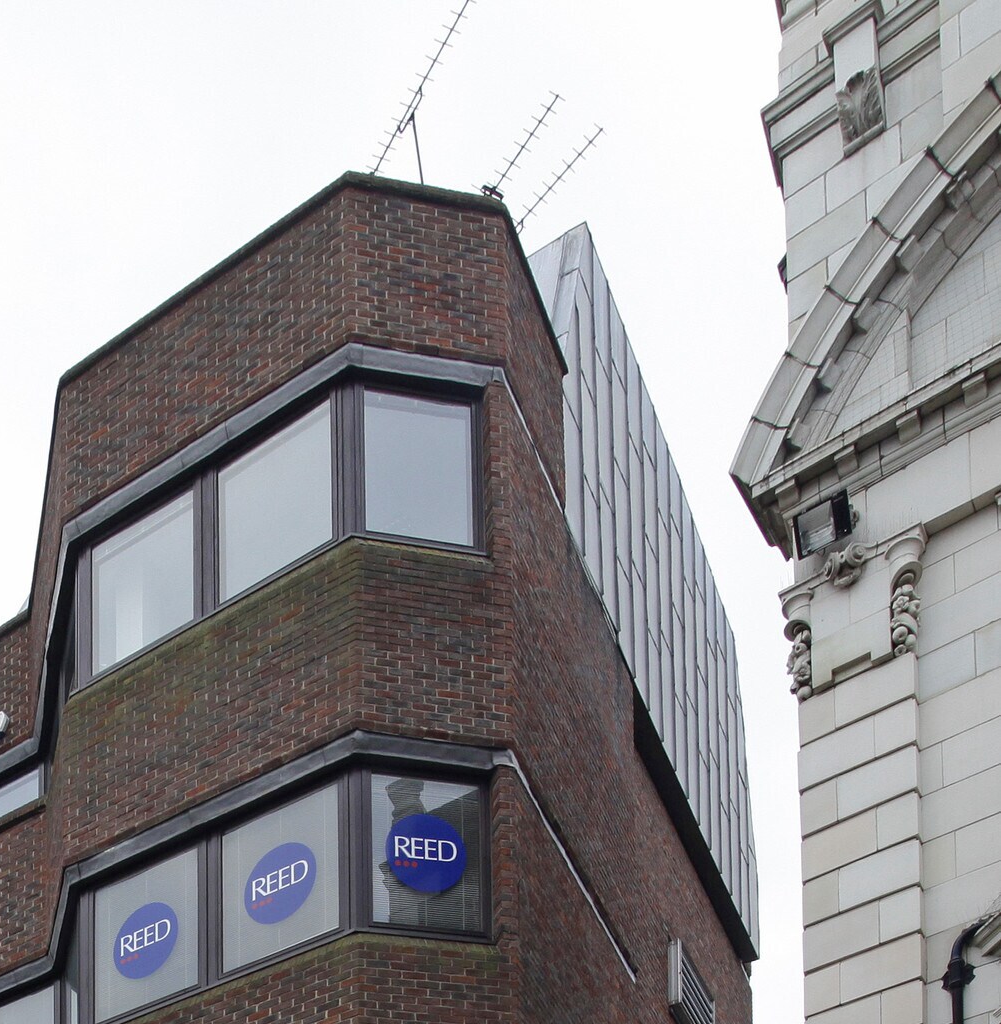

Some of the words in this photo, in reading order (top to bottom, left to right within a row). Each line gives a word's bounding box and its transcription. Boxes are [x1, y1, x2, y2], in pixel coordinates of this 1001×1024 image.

[394, 835, 457, 862] REED
[251, 859, 309, 902] REED
[120, 918, 171, 957] REED
